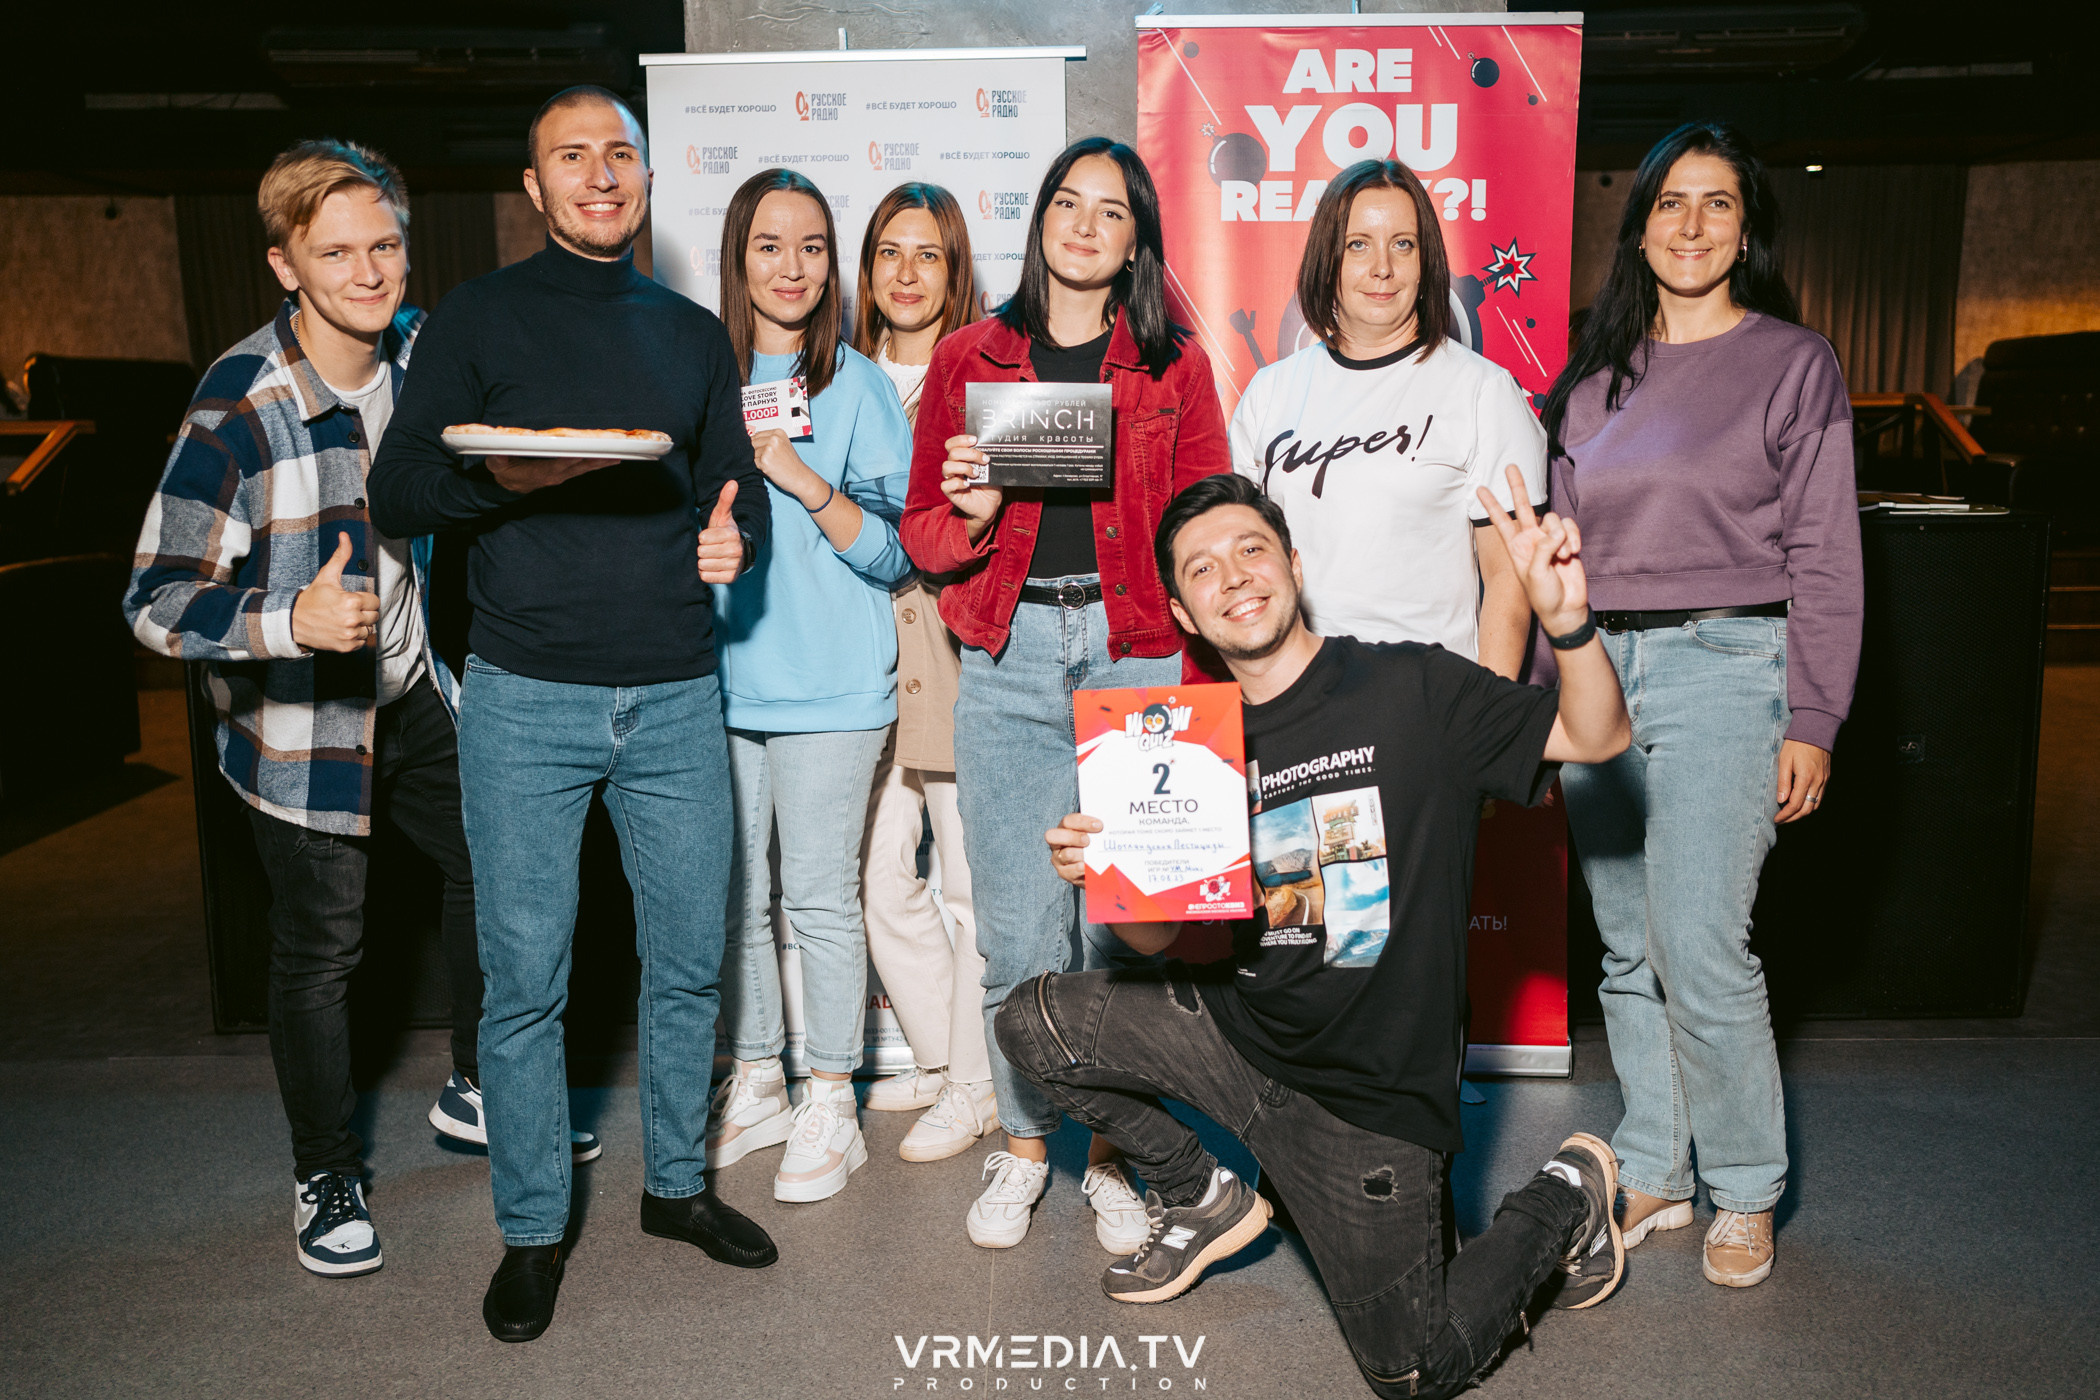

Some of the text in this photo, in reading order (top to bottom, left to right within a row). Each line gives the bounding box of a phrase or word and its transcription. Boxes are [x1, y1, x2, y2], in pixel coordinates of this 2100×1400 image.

[1282, 48, 1412, 93] ARE
[811, 93, 847, 106] РУССКОЕ
[992, 90, 1028, 104] РУССКОЕ
[708, 105, 735, 114] БУДЕТ
[738, 104, 777, 113] ХОРОШО
[889, 102, 916, 111] БУДЕТ
[918, 101, 957, 109] ХОРОШО
[992, 104, 1018, 118] РАДИО
[812, 108, 838, 121] РАДИО
[1244, 102, 1458, 172] YOU
[702, 146, 738, 160] РУССКОЕ
[884, 142, 920, 156] РУССКОЕ
[963, 152, 990, 161] БУДЕТ
[992, 151, 1030, 159] ХОРОШО
[782, 156, 808, 164] БУДЕТ
[810, 154, 850, 162] ХОРОШО
[884, 157, 911, 170] РАДИО
[702, 161, 730, 174] РАДИО
[994, 192, 1029, 206] РУССКОЕ
[1220, 177, 1486, 222] REA?!
[994, 206, 1020, 220] РАДИО
[748, 397, 778, 407] ПАРНУЮ
[983, 409, 1094, 430] BRINCH
[1040, 435, 1094, 443] красоты
[1138, 730, 1175, 752] QUIZ
[1261, 746, 1375, 792] PHOTOGRAPHY
[1152, 763, 1171, 795] 2
[1316, 772, 1340, 782] GOOD
[1129, 799, 1198, 814] МЕСТО
[1468, 916, 1507, 931] АТЬ!
